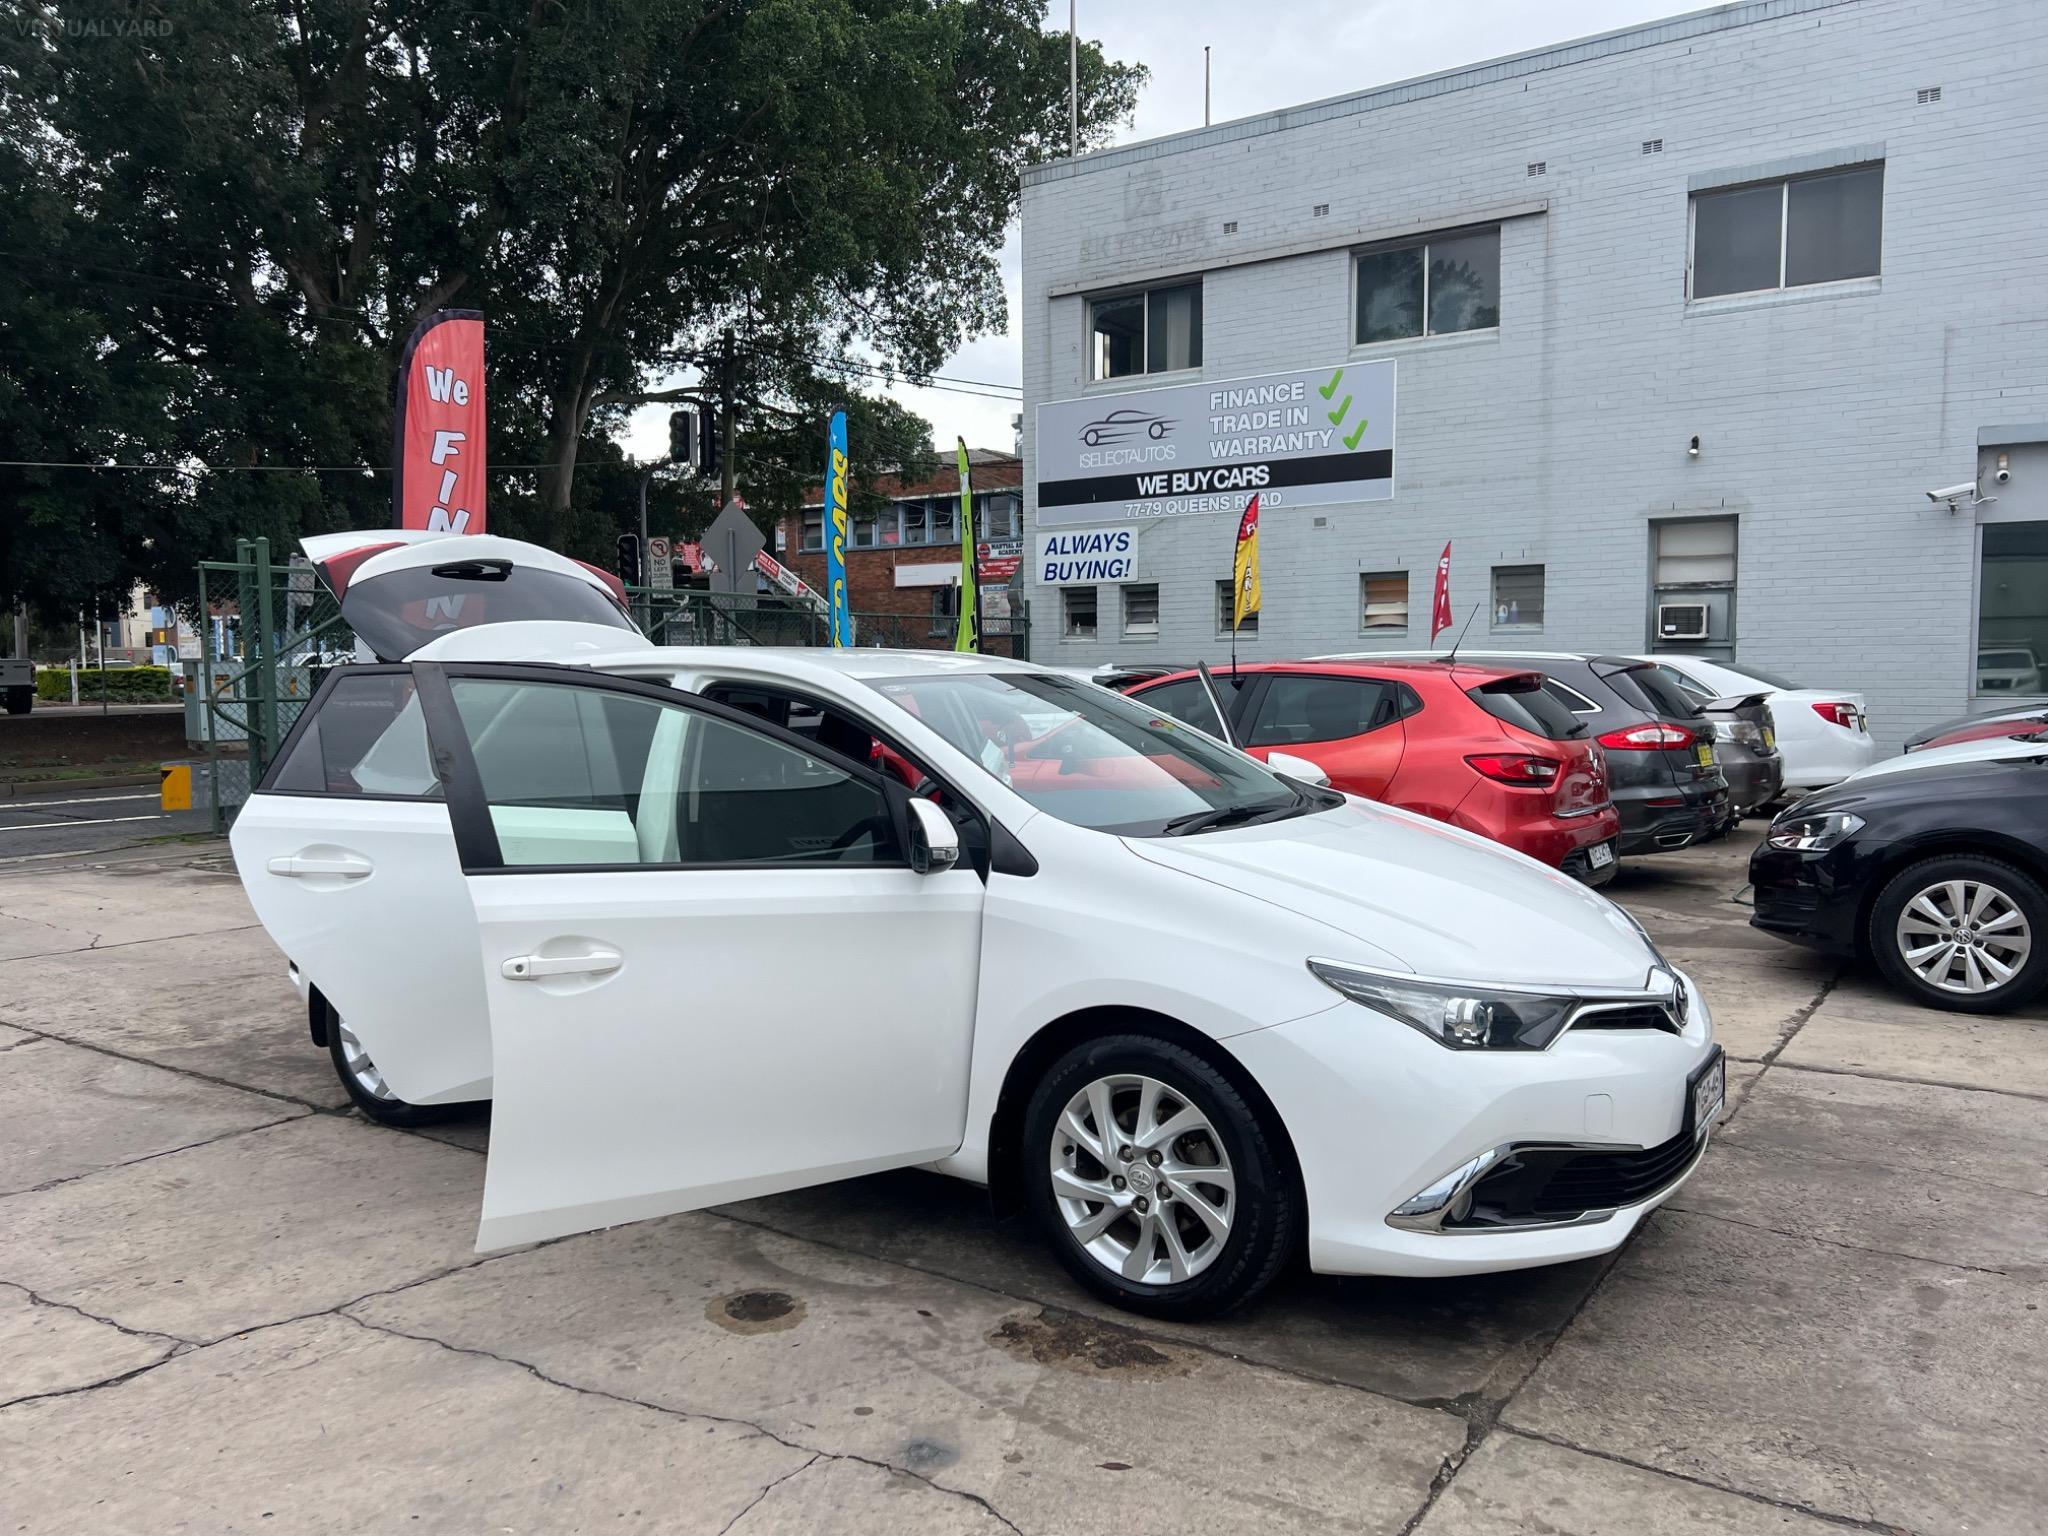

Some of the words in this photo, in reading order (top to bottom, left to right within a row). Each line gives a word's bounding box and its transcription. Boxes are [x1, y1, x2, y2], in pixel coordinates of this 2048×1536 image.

[425, 365, 469, 407] We
[1209, 381, 1306, 411] FINANCE
[1208, 410, 1282, 435] TRADE
[1285, 406, 1309, 427] IN
[1208, 428, 1336, 459] WARRANTY
[1136, 474, 1169, 497] WE
[1172, 470, 1214, 493] BUY
[1213, 465, 1271, 488] CARS
[1124, 502, 1163, 518] 77-79
[1165, 497, 1231, 515] QUEENS
[1044, 532, 1131, 556] ALWAYS
[1043, 558, 1132, 581] BUYING!
